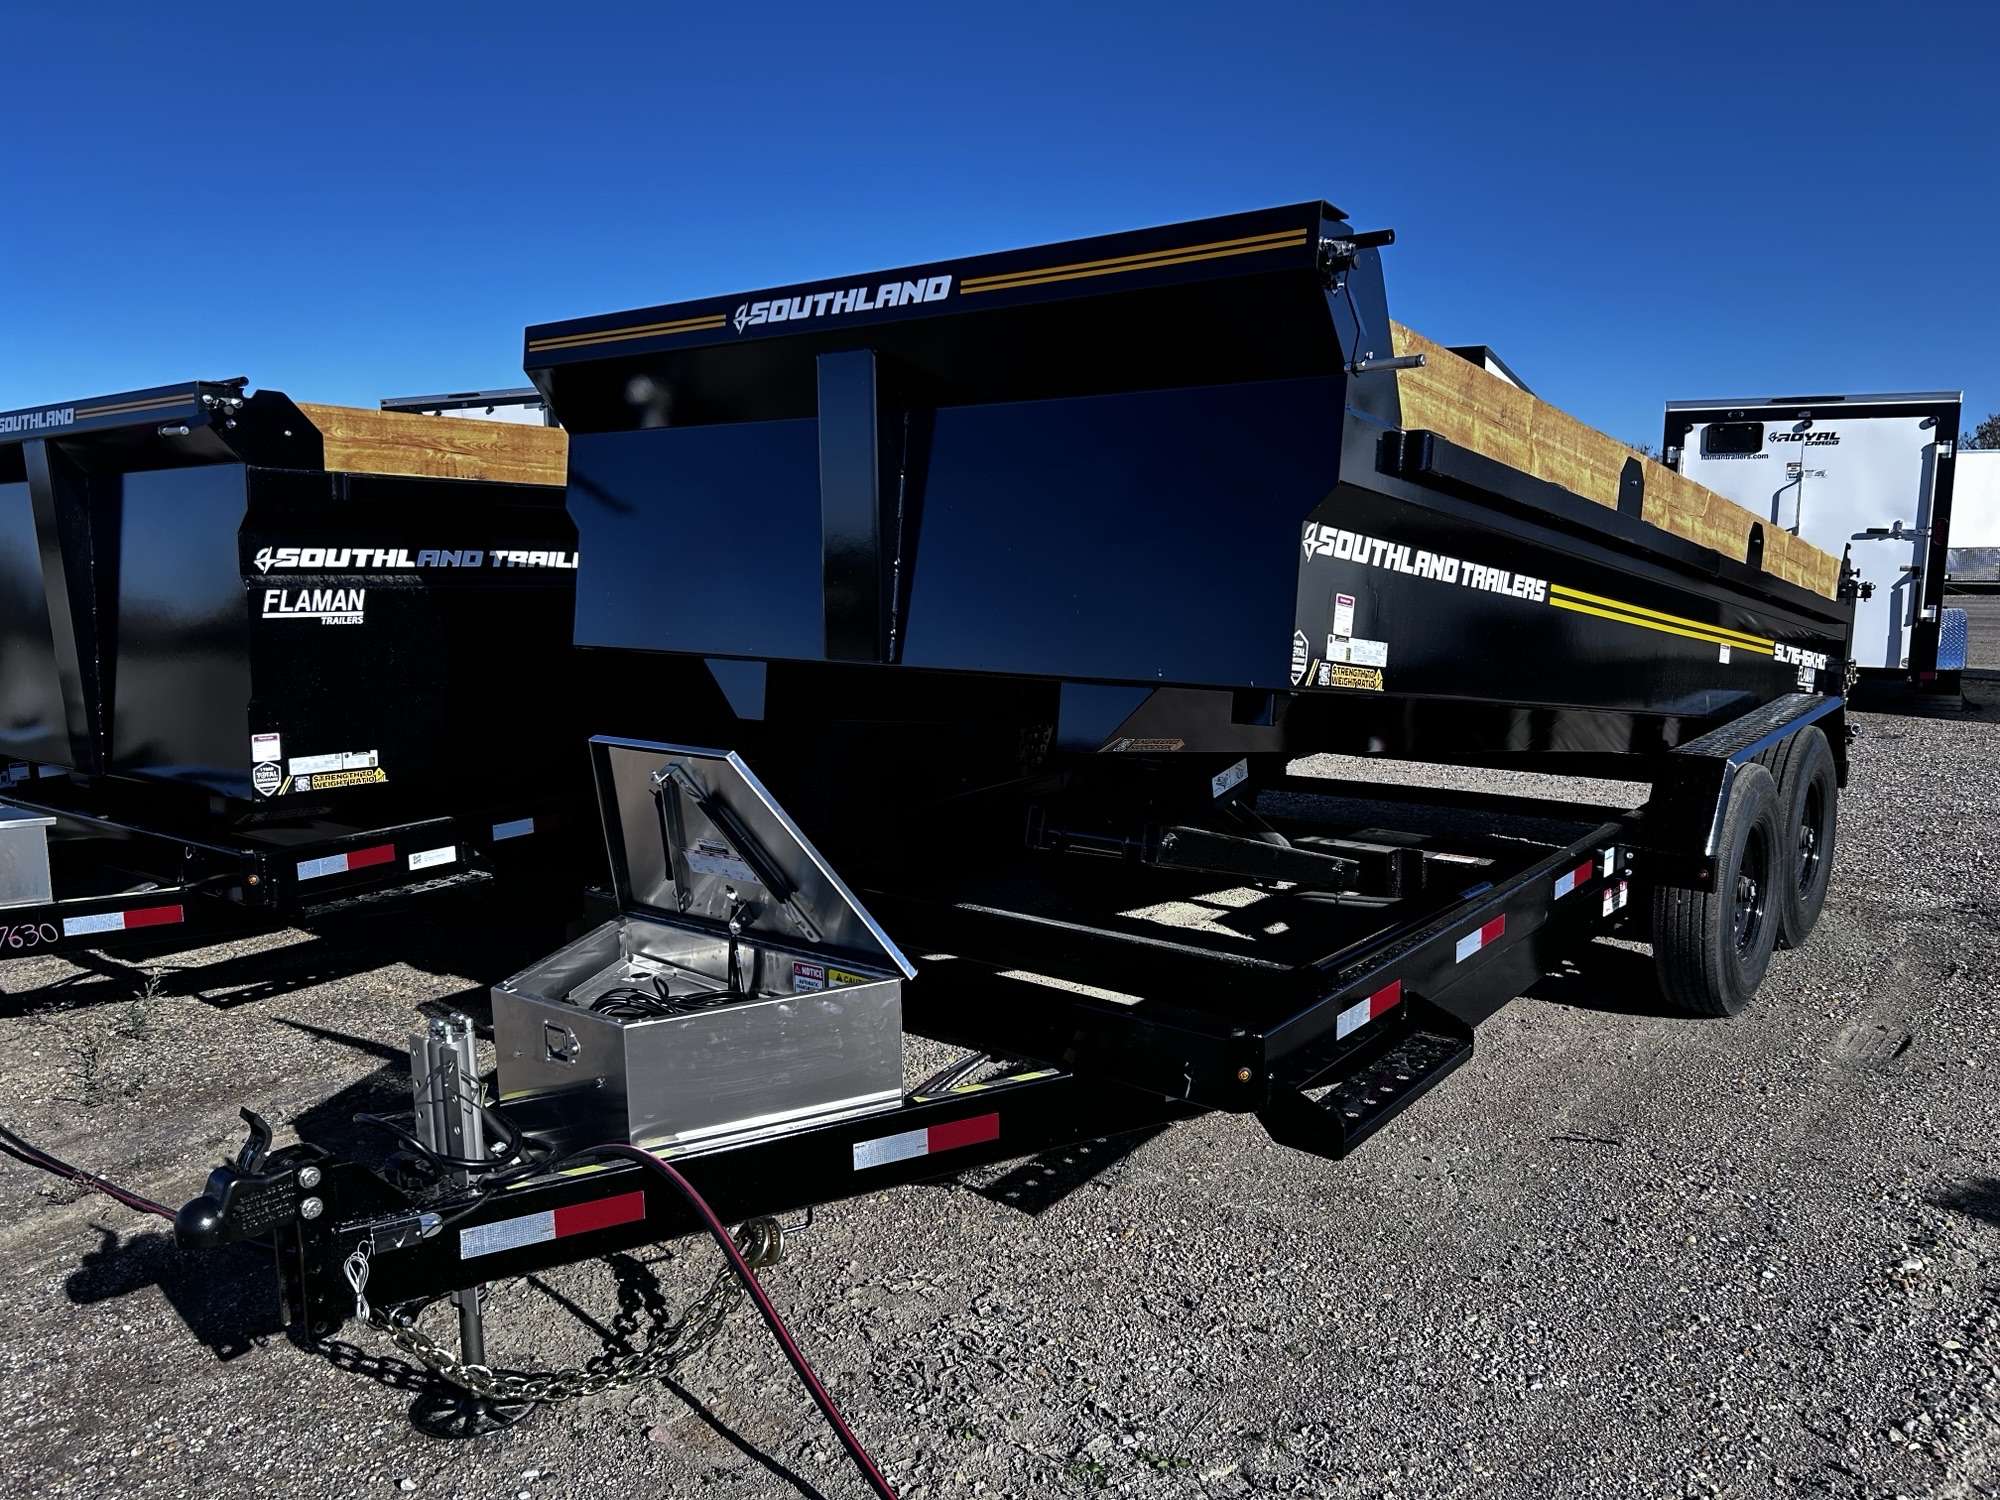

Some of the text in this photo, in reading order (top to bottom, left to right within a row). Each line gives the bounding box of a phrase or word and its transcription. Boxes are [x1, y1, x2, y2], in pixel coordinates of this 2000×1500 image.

[748, 274, 953, 326] SOUTHLAND
[0, 408, 74, 433] SOUTHLAND
[1777, 432, 1840, 442] ROYAL
[274, 548, 484, 568] SOUTHLAND
[1315, 524, 1548, 602] SOUTHLAND TRAILERS
[263, 589, 365, 612] FLAMAN
[321, 616, 364, 625] TRAILERS
[1332, 665, 1366, 678] STRENGTH
[1332, 676, 1375, 688] WEIGHT RATIO
[313, 770, 373, 783] STRENGTH TO
[313, 777, 374, 789] WEIGHT RATIO
[801, 966, 823, 979] NOTICE
